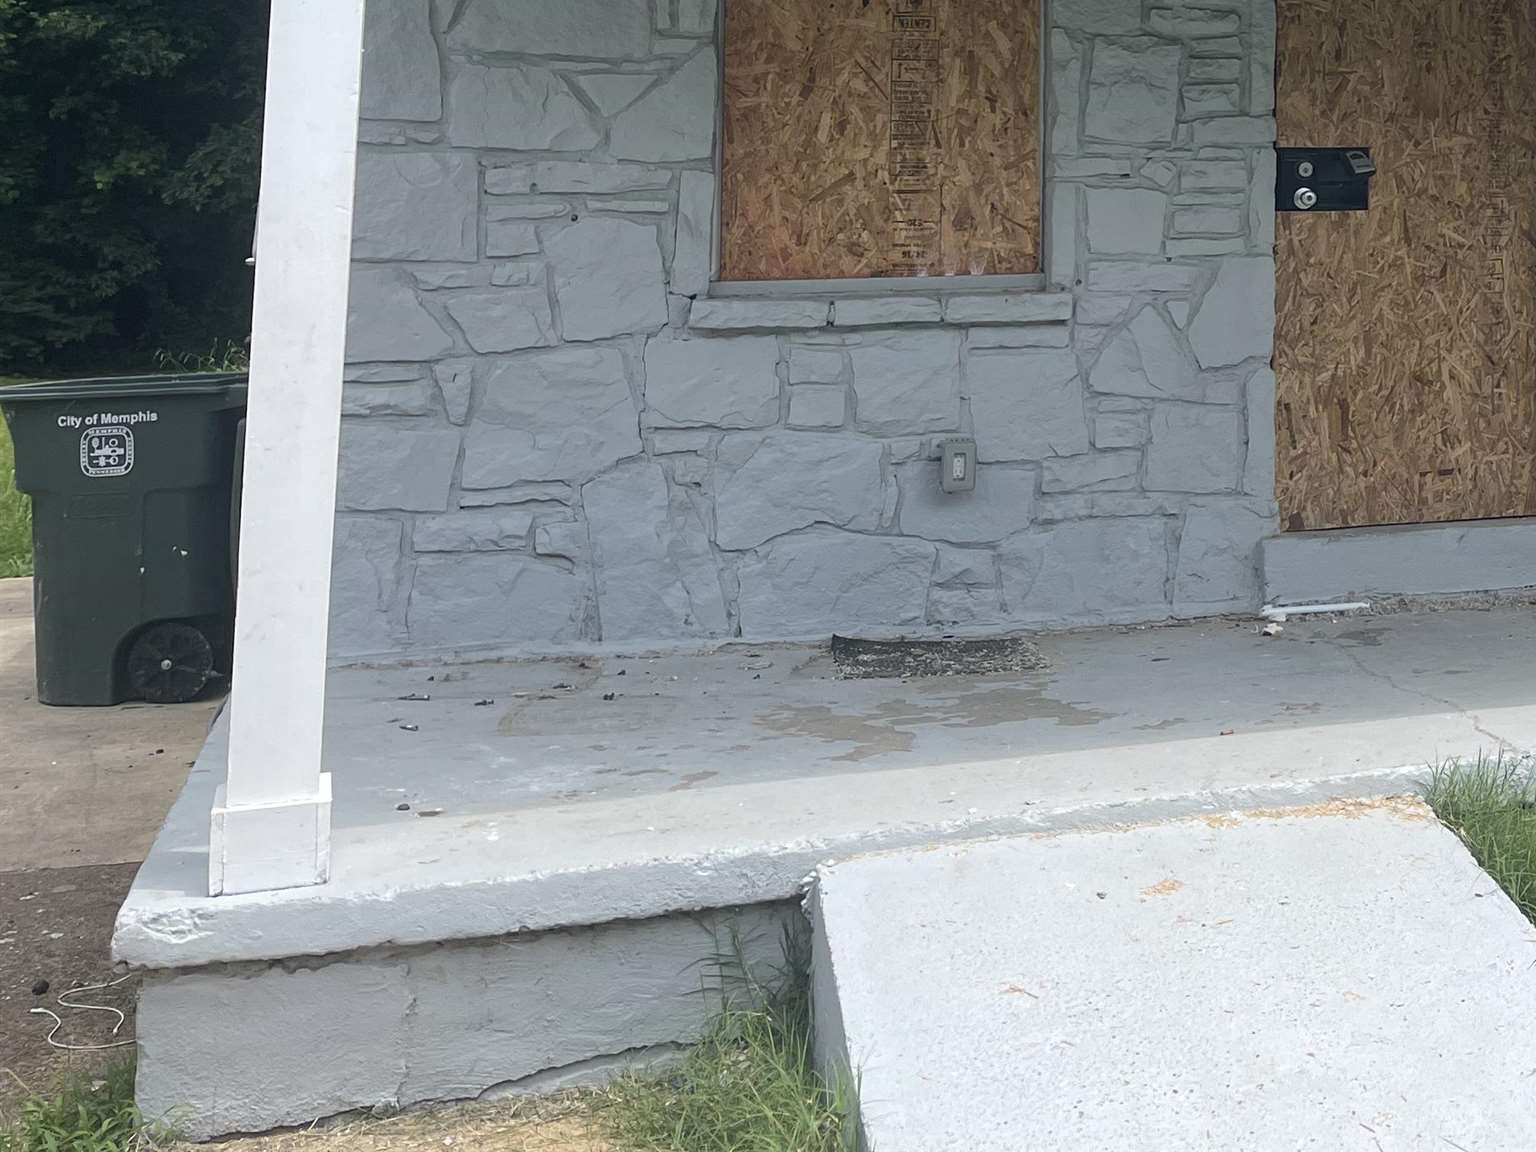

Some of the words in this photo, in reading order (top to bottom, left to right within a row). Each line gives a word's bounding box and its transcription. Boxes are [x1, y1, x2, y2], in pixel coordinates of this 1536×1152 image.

[57, 416, 82, 429] City
[85, 413, 99, 425] of
[100, 410, 158, 425] Memphis
